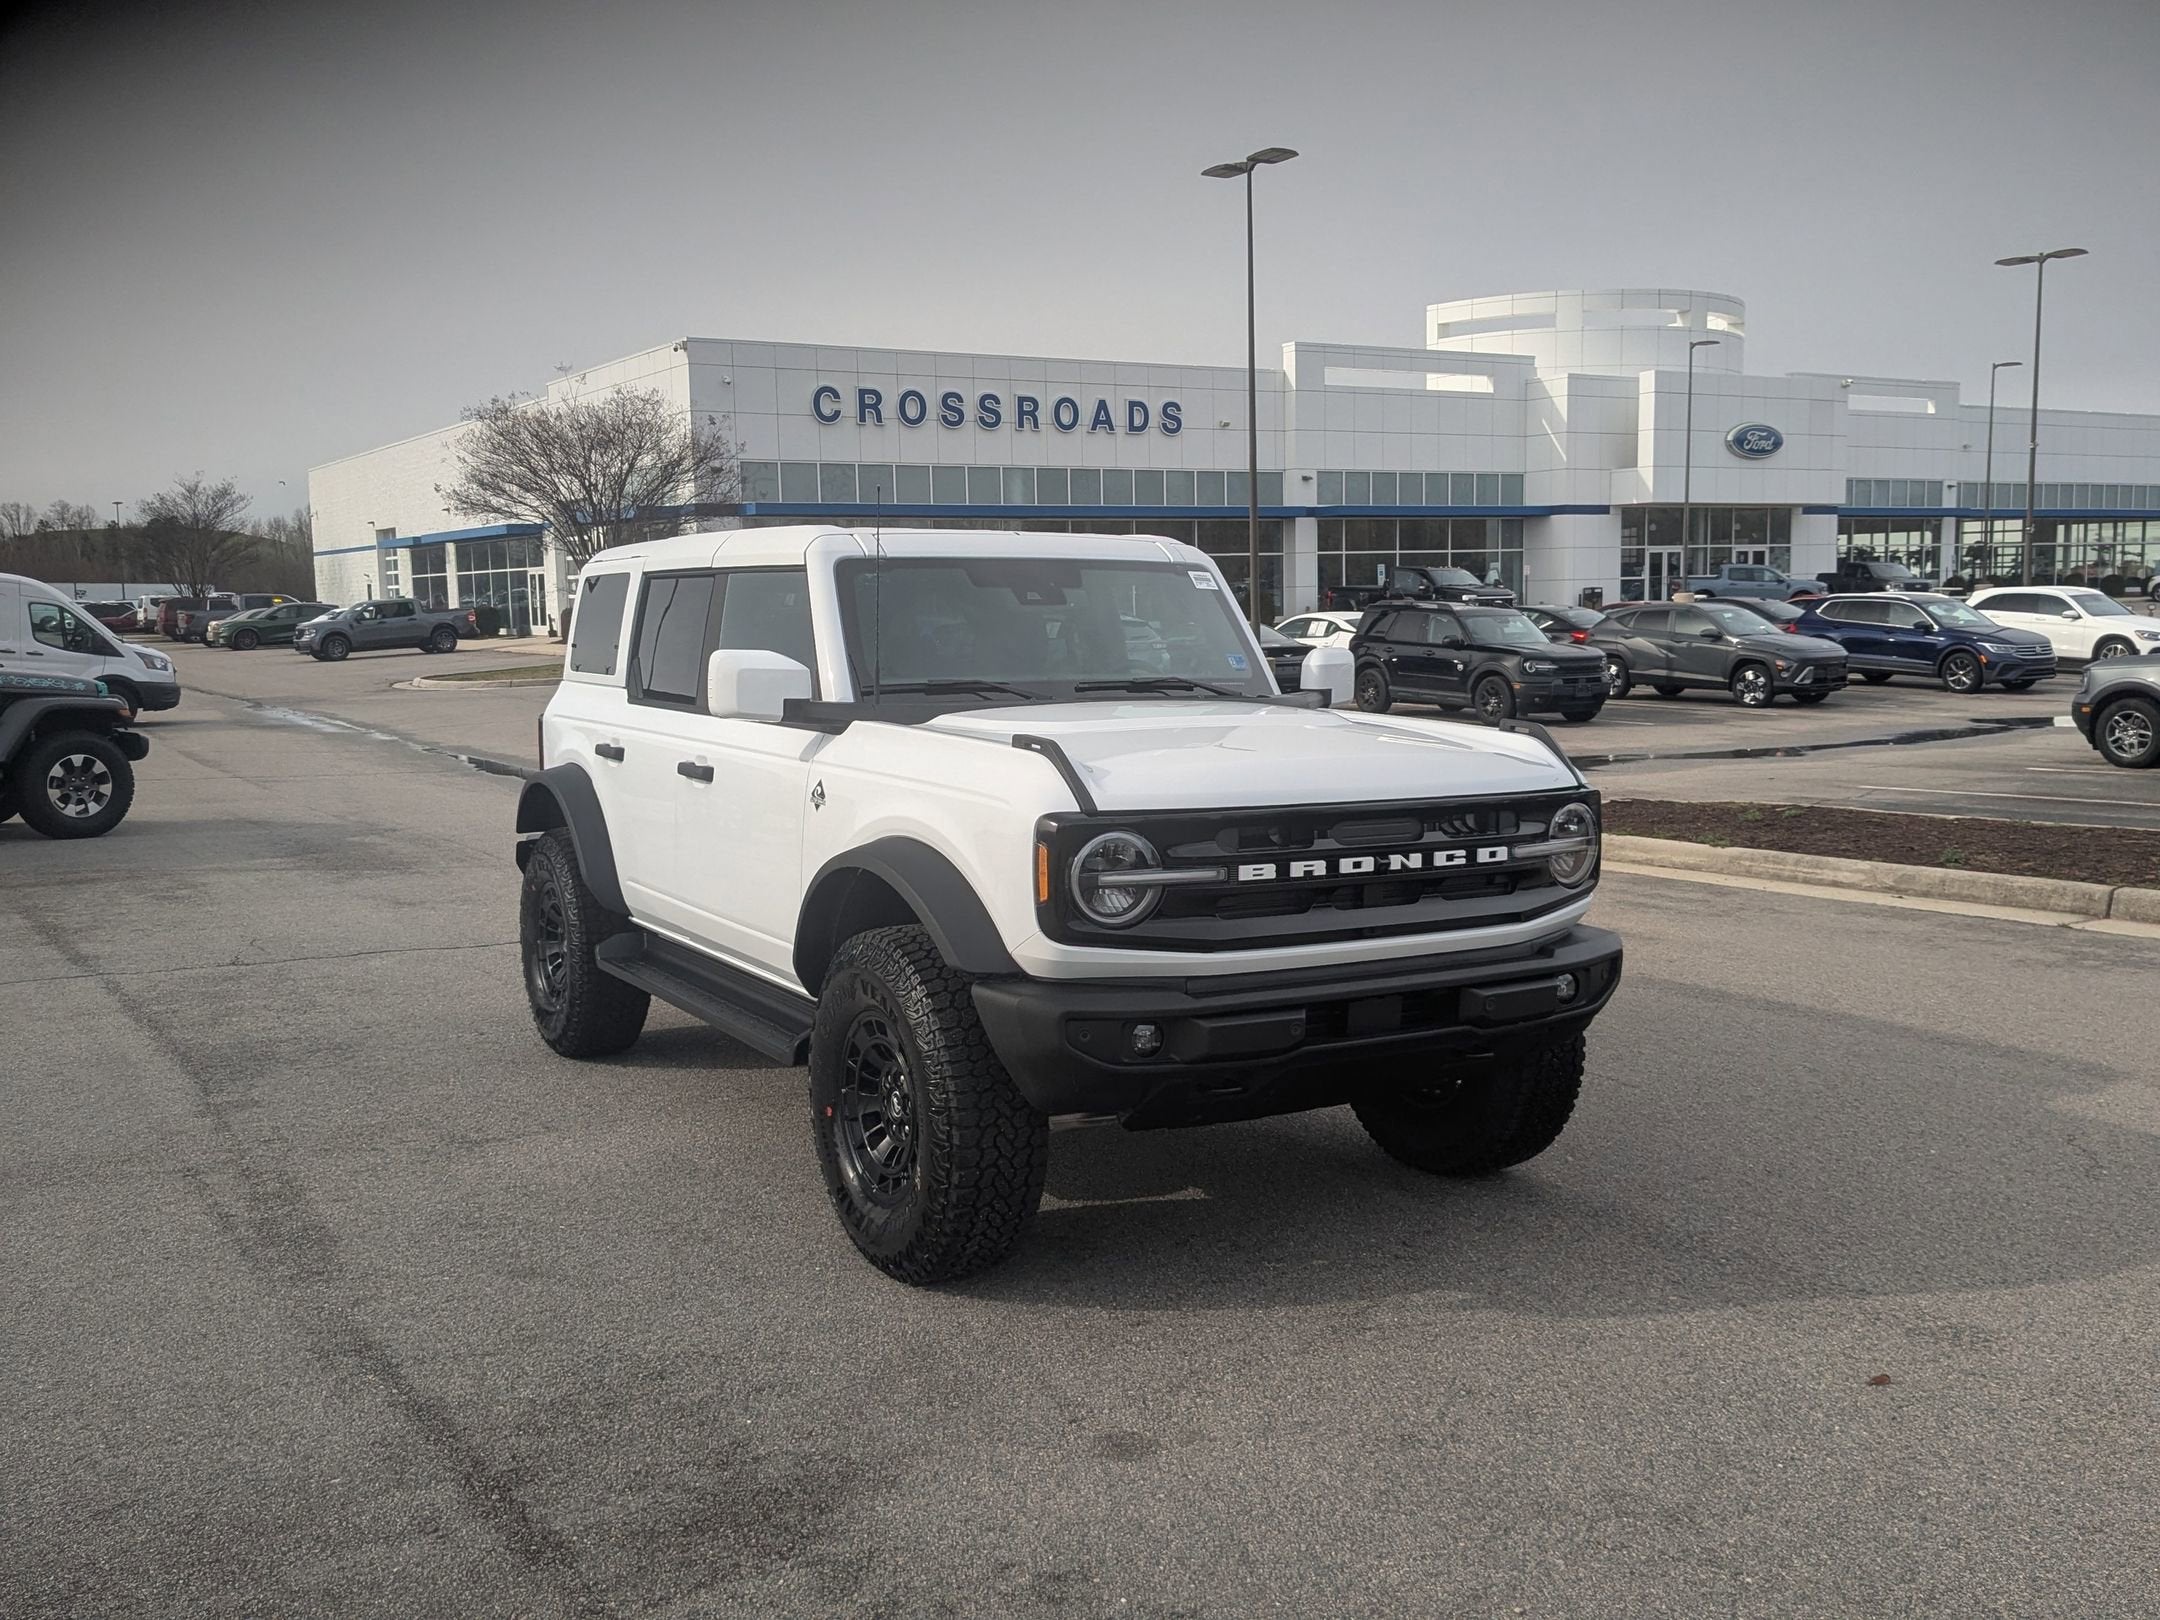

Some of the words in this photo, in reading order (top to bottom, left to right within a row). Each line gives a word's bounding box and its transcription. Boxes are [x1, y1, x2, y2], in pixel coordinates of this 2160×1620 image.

[811, 383, 1184, 437] CROSSROADS
[1743, 430, 1776, 450] Ford
[1238, 846, 1508, 881] BRONCO
